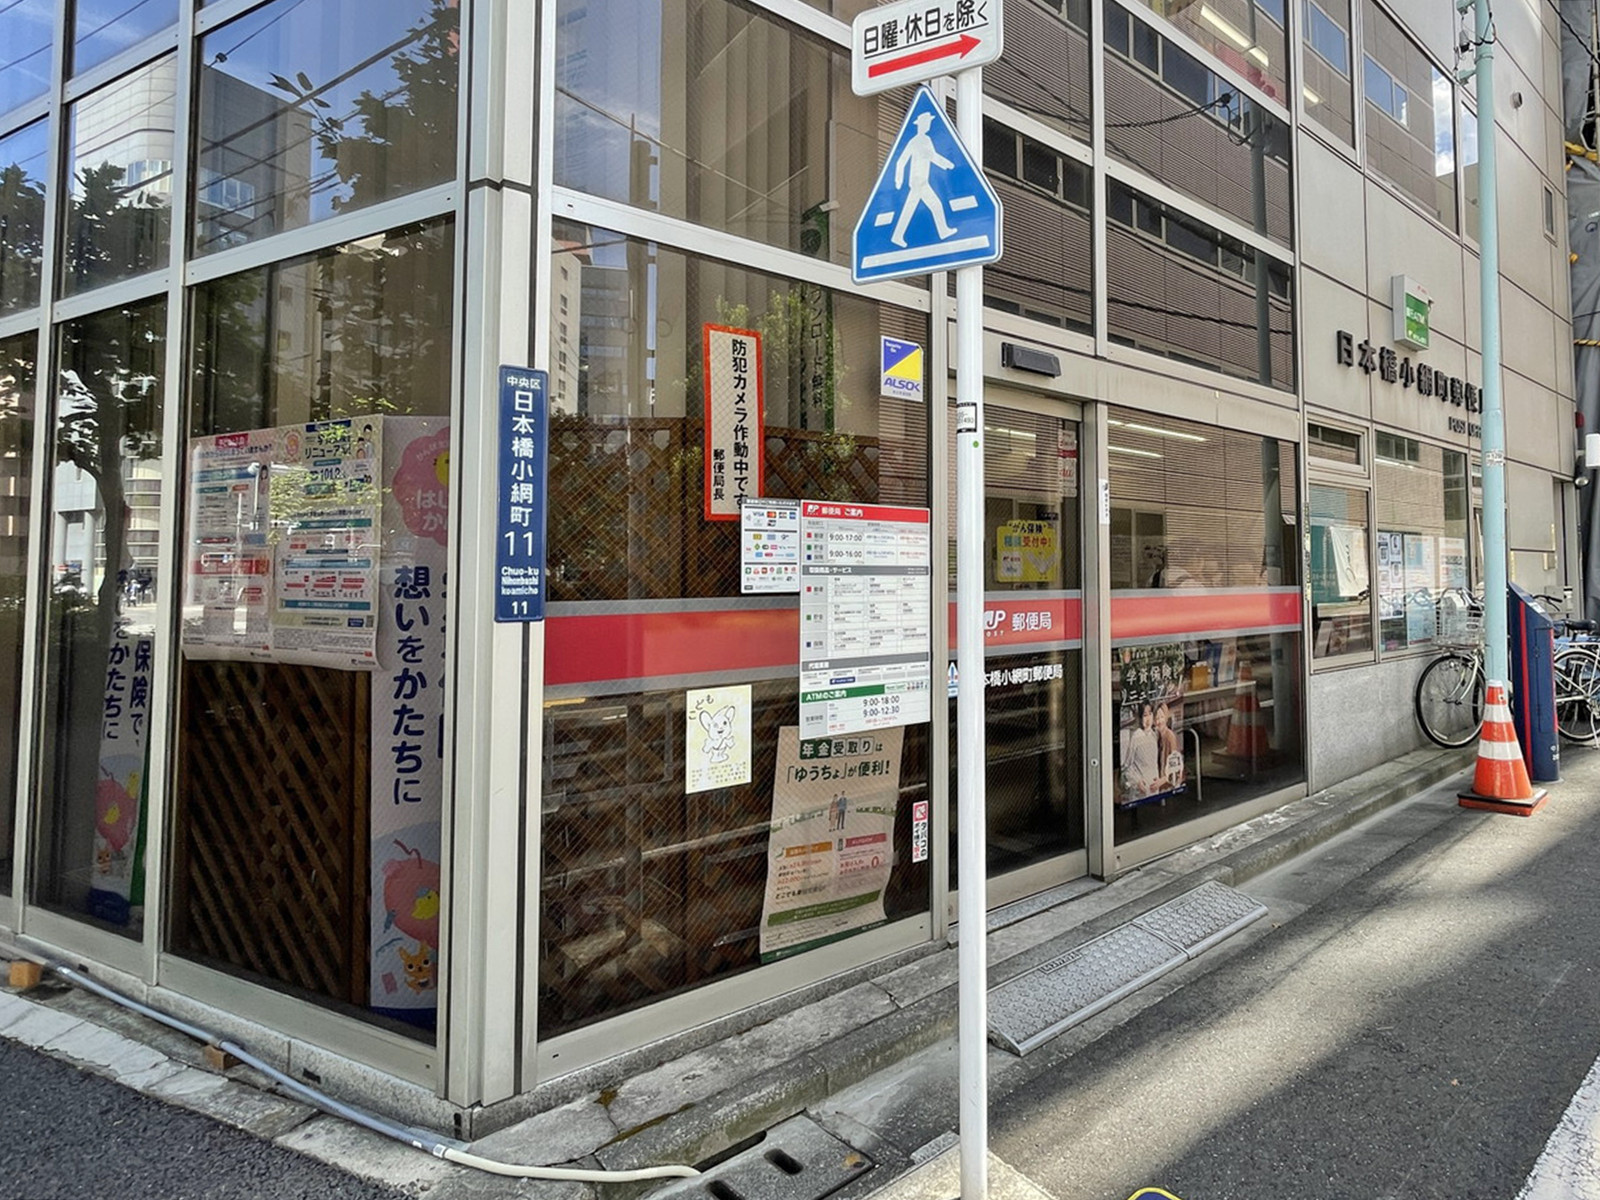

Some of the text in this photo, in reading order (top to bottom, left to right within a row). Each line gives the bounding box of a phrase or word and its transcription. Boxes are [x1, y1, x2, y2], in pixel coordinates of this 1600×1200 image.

[864, 0, 988, 55] 日曜・休日を除く
[1336, 329, 1483, 415] 日本橋小網町郵便
[506, 375, 541, 390] 中央区
[883, 377, 921, 393] ALSOK
[731, 338, 749, 510] 防犯カメラ作動中です
[510, 389, 535, 528] 日本橋小網町
[712, 448, 726, 502] 郵便局長
[844, 508, 864, 518] ご案内
[504, 530, 534, 557] 11
[829, 533, 863, 542] 9:00-17:00
[829, 549, 863, 558] 9:00-16:00
[501, 566, 540, 576] Chuo-ku
[511, 600, 528, 615] 11
[1011, 611, 1052, 632] 郵便局
[391, 565, 431, 806] 想いをかたちに
[805, 690, 847, 701] ATMのご案内
[863, 695, 900, 707] 9:00-18:00
[863, 705, 900, 718] 9:00-12:30
[801, 740, 883, 758] 年金受取りは
